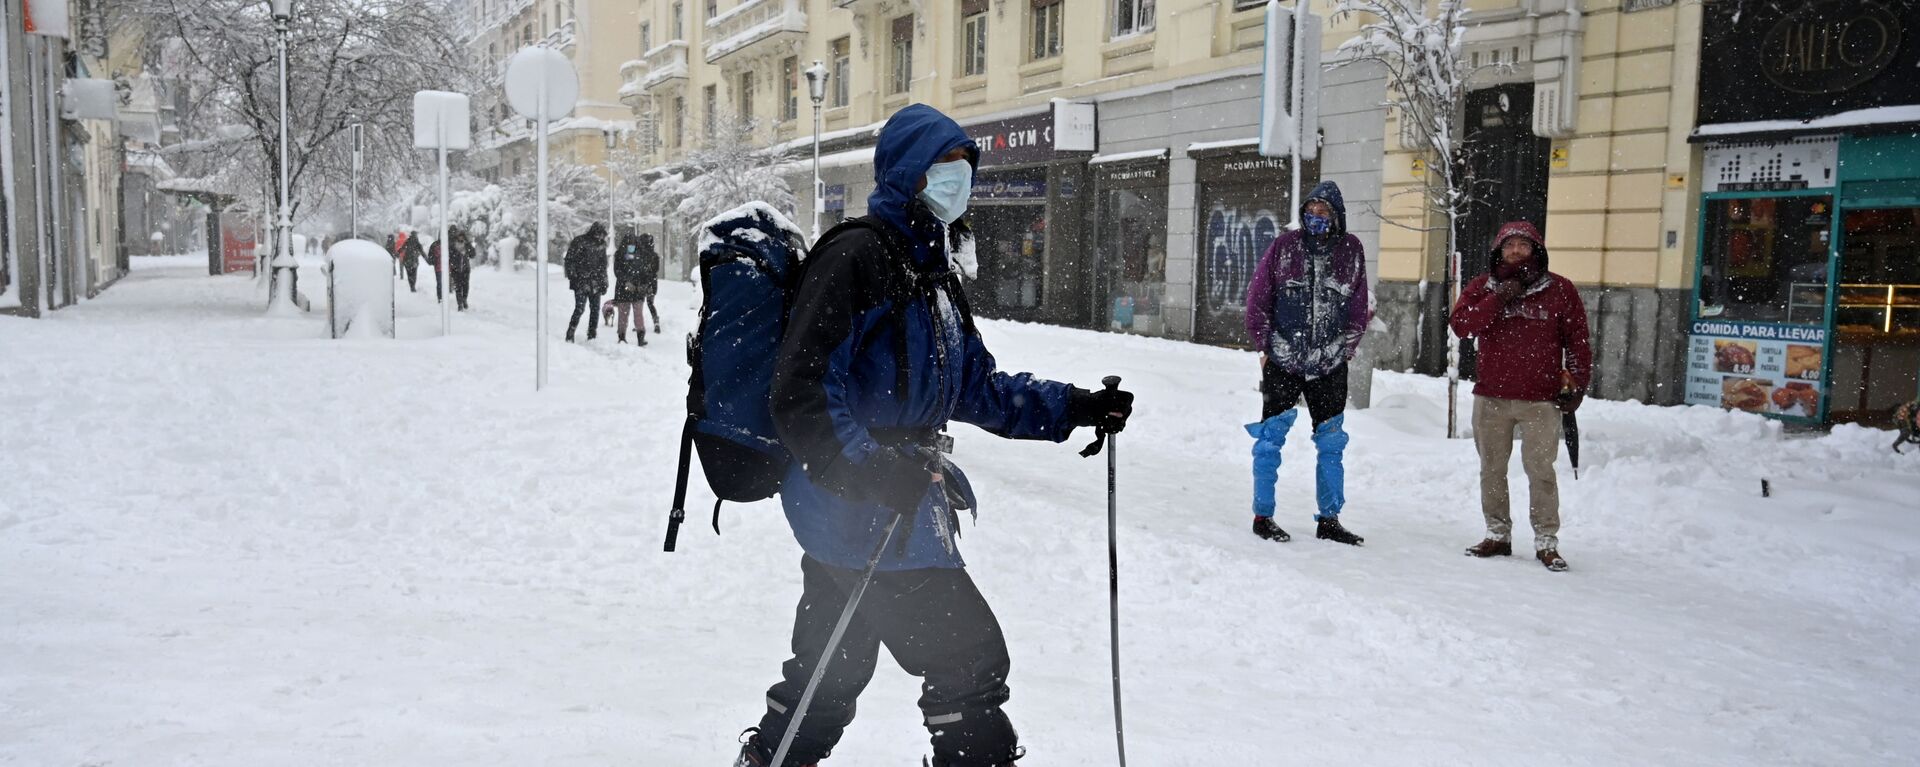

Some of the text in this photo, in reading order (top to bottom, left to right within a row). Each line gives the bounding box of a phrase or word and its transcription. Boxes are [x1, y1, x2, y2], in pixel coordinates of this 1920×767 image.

[975, 135, 993, 152] FIT
[1008, 129, 1037, 148] GYM
[1693, 322, 1825, 341] COMIDA PARA LLEVAR
